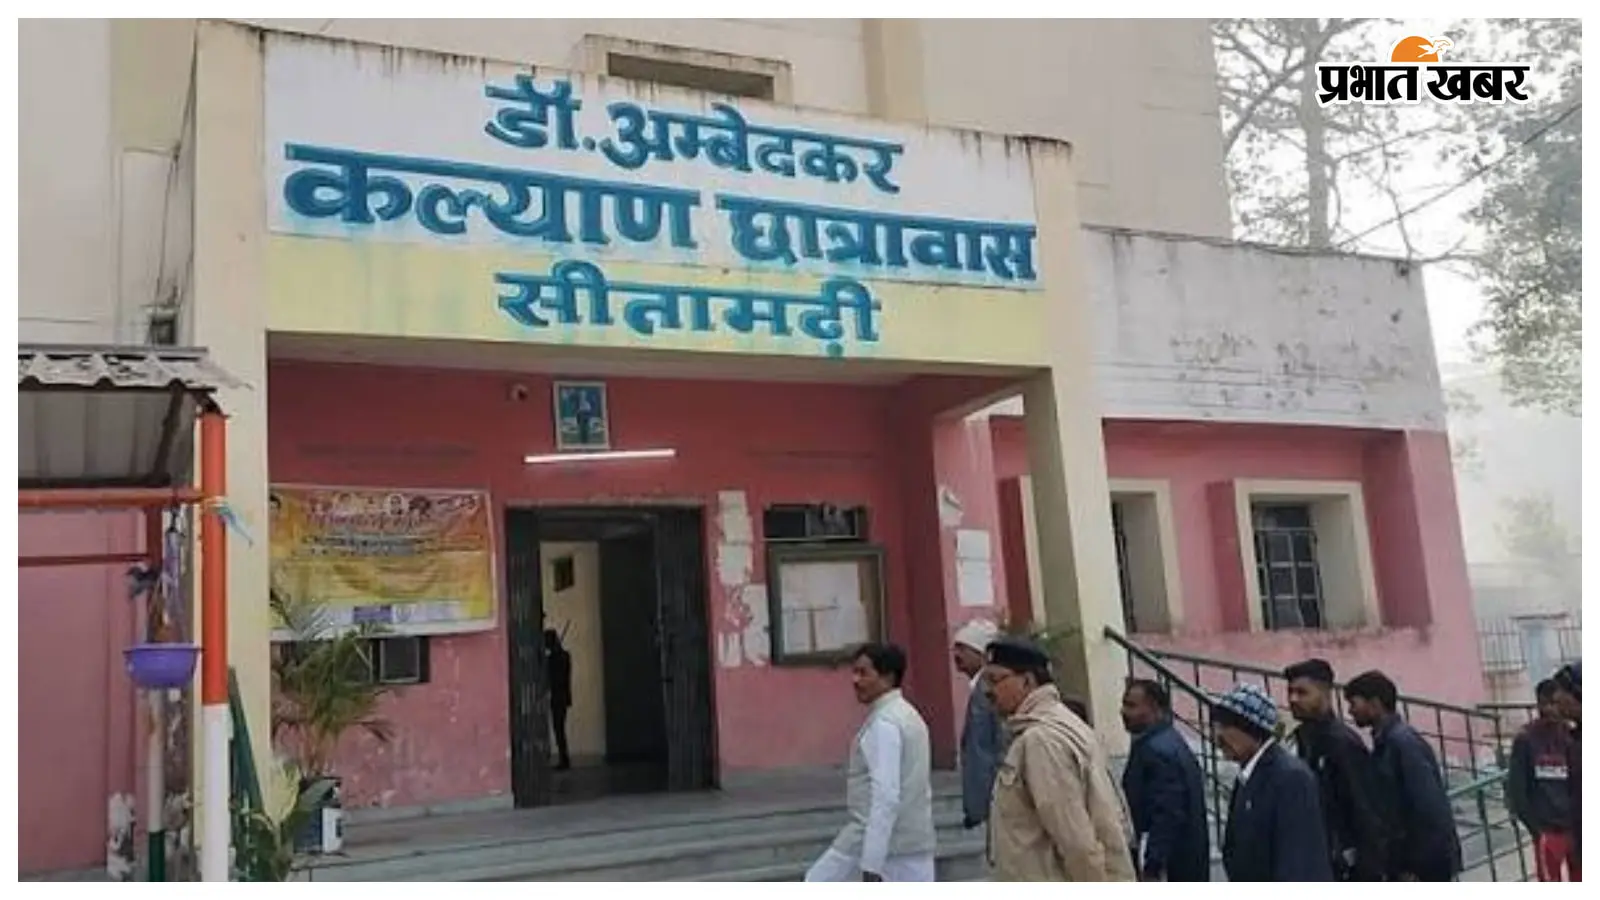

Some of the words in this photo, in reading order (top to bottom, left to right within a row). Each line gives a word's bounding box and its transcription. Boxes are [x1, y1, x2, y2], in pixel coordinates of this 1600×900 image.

[284, 143, 700, 249] कल्याण
[718, 194, 1038, 281] छात्रावास
[495, 261, 882, 357] सीतामढ़ी
